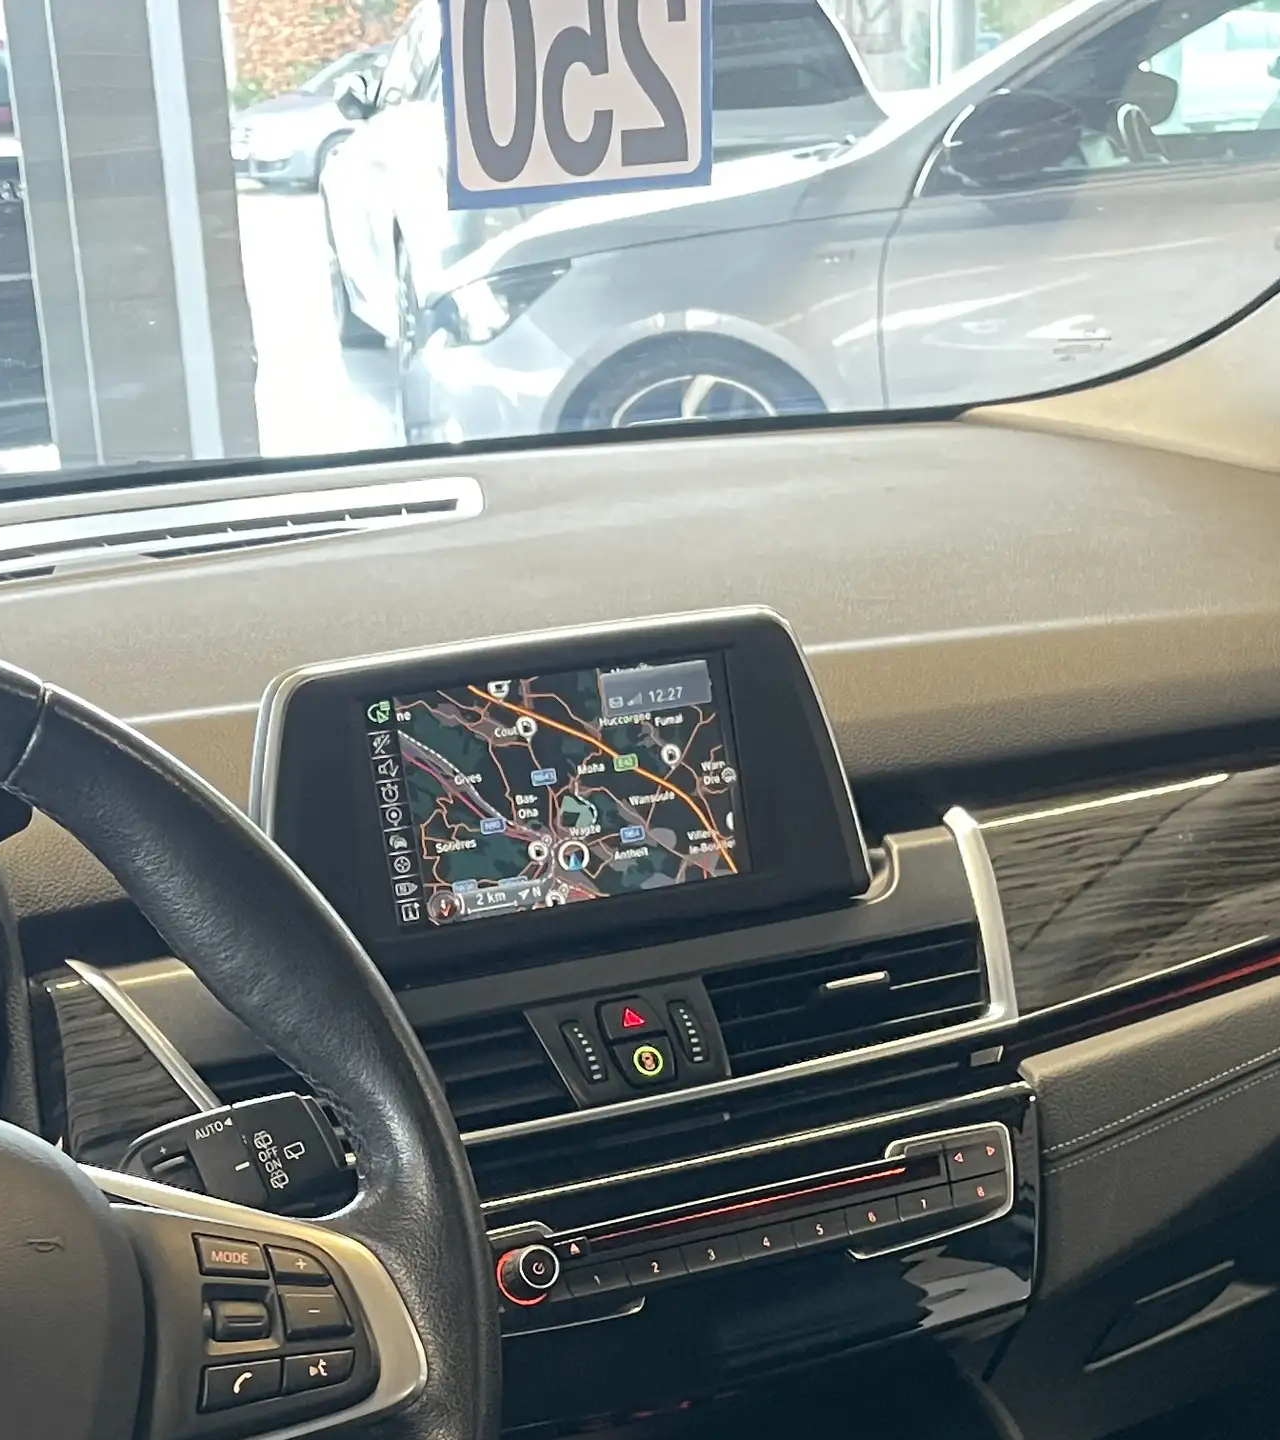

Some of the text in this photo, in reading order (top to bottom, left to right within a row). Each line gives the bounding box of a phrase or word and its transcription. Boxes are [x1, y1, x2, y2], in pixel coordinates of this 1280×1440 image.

[475, 891, 507, 905] 2 km
[194, 1120, 224, 1140] AUTO
[258, 1145, 279, 1162] OFF
[264, 1158, 283, 1173] ON
[593, 1274, 601, 1286] 1
[651, 1261, 661, 1273] 2
[707, 1248, 716, 1261] 3
[762, 1236, 771, 1248] 4
[815, 1223, 825, 1236] 5
[867, 1211, 877, 1223] 6
[976, 1186, 985, 1198] 8
[211, 1251, 249, 1266] MODE
